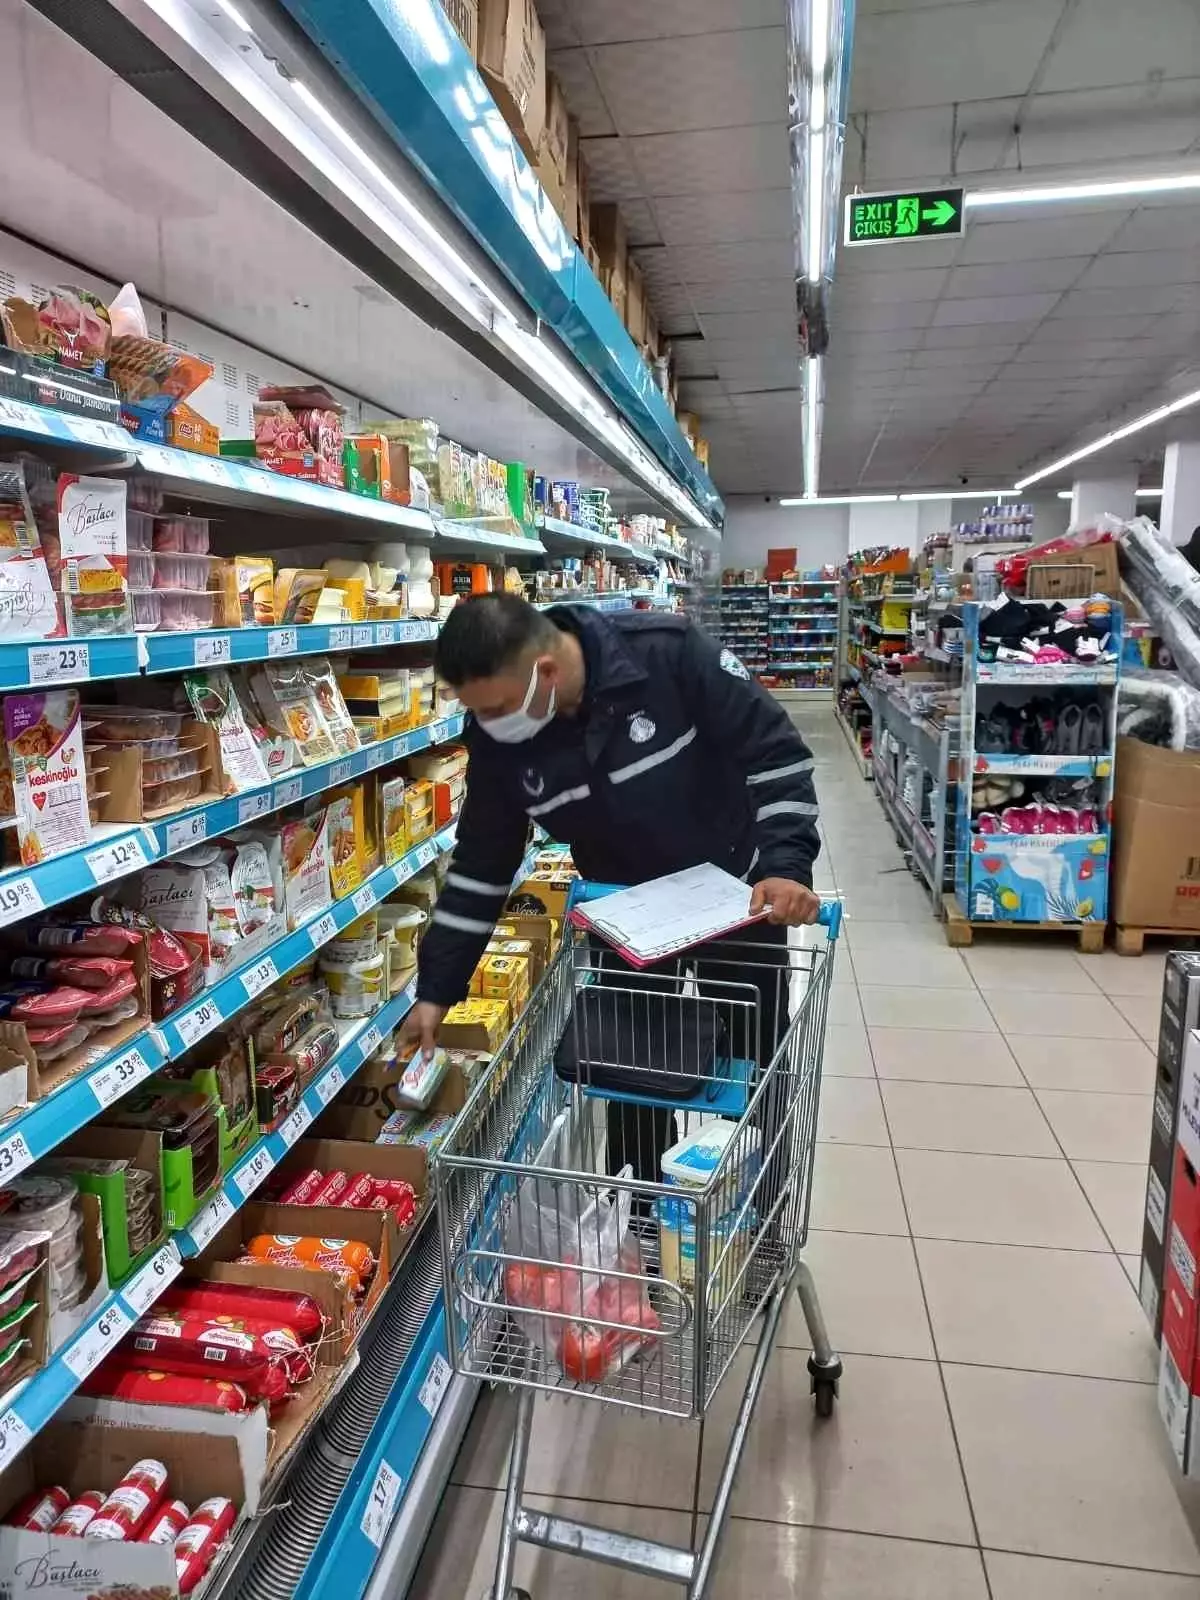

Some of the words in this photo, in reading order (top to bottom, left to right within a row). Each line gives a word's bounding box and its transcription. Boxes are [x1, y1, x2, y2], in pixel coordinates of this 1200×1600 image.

[855, 203, 892, 220] EXIT
[855, 220, 892, 237] ÇIKIŞ
[58, 346, 83, 361] NAMET
[59, 648, 88, 669] 23,65
[28, 766, 78, 788] keskinoğlu
[111, 841, 136, 865] 12,90
[115, 1051, 140, 1081] 33,95
[0, 1138, 23, 1171] 3,50
[153, 1252, 169, 1276] 6,95
[98, 1307, 118, 1337] 6,50
